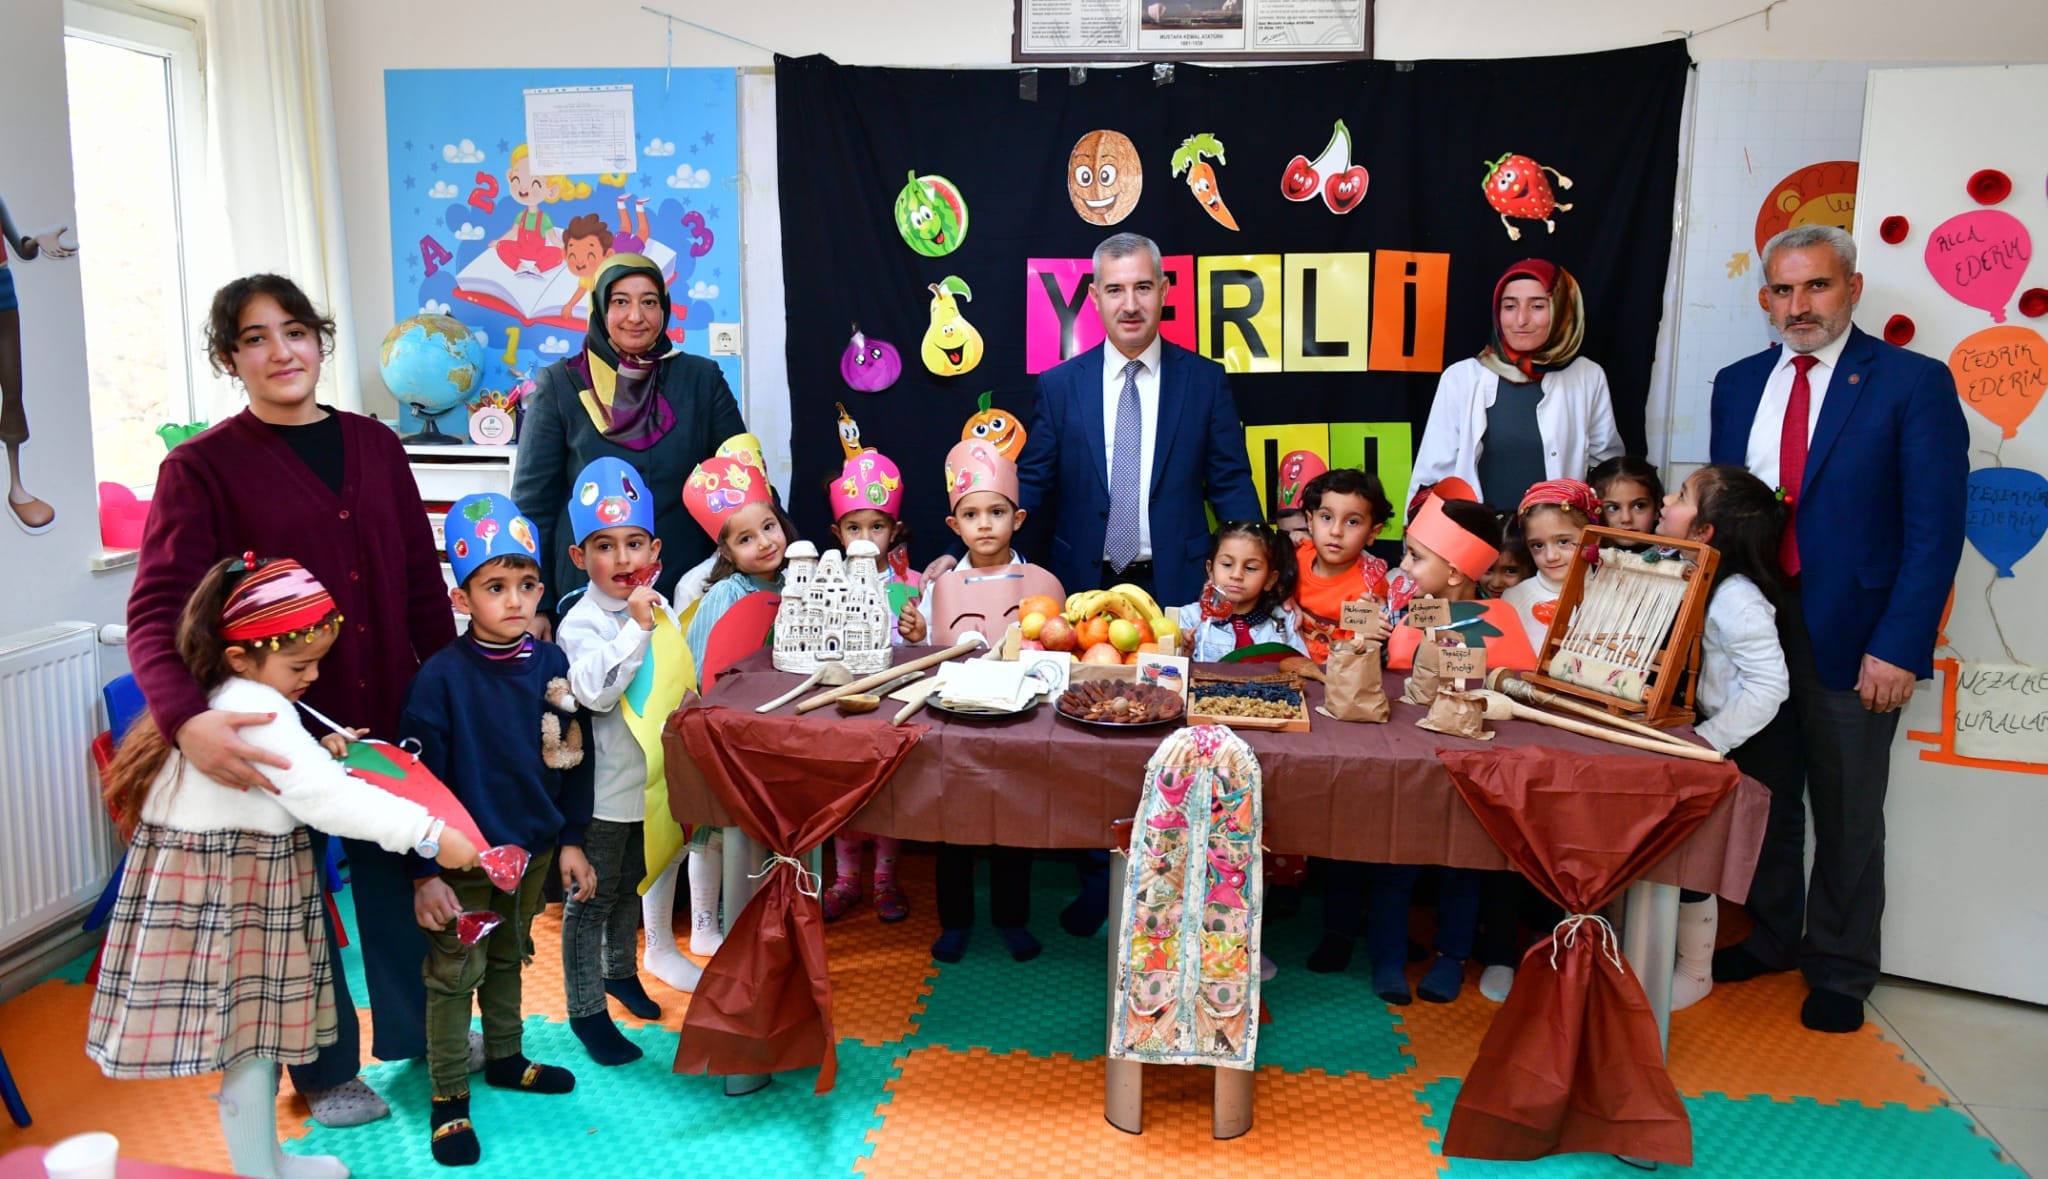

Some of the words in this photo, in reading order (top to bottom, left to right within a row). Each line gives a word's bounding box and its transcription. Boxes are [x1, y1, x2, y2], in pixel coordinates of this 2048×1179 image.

[468, 171, 499, 215] 2
[419, 234, 453, 278] A
[681, 211, 714, 257] 3
[502, 326, 520, 366] 1
